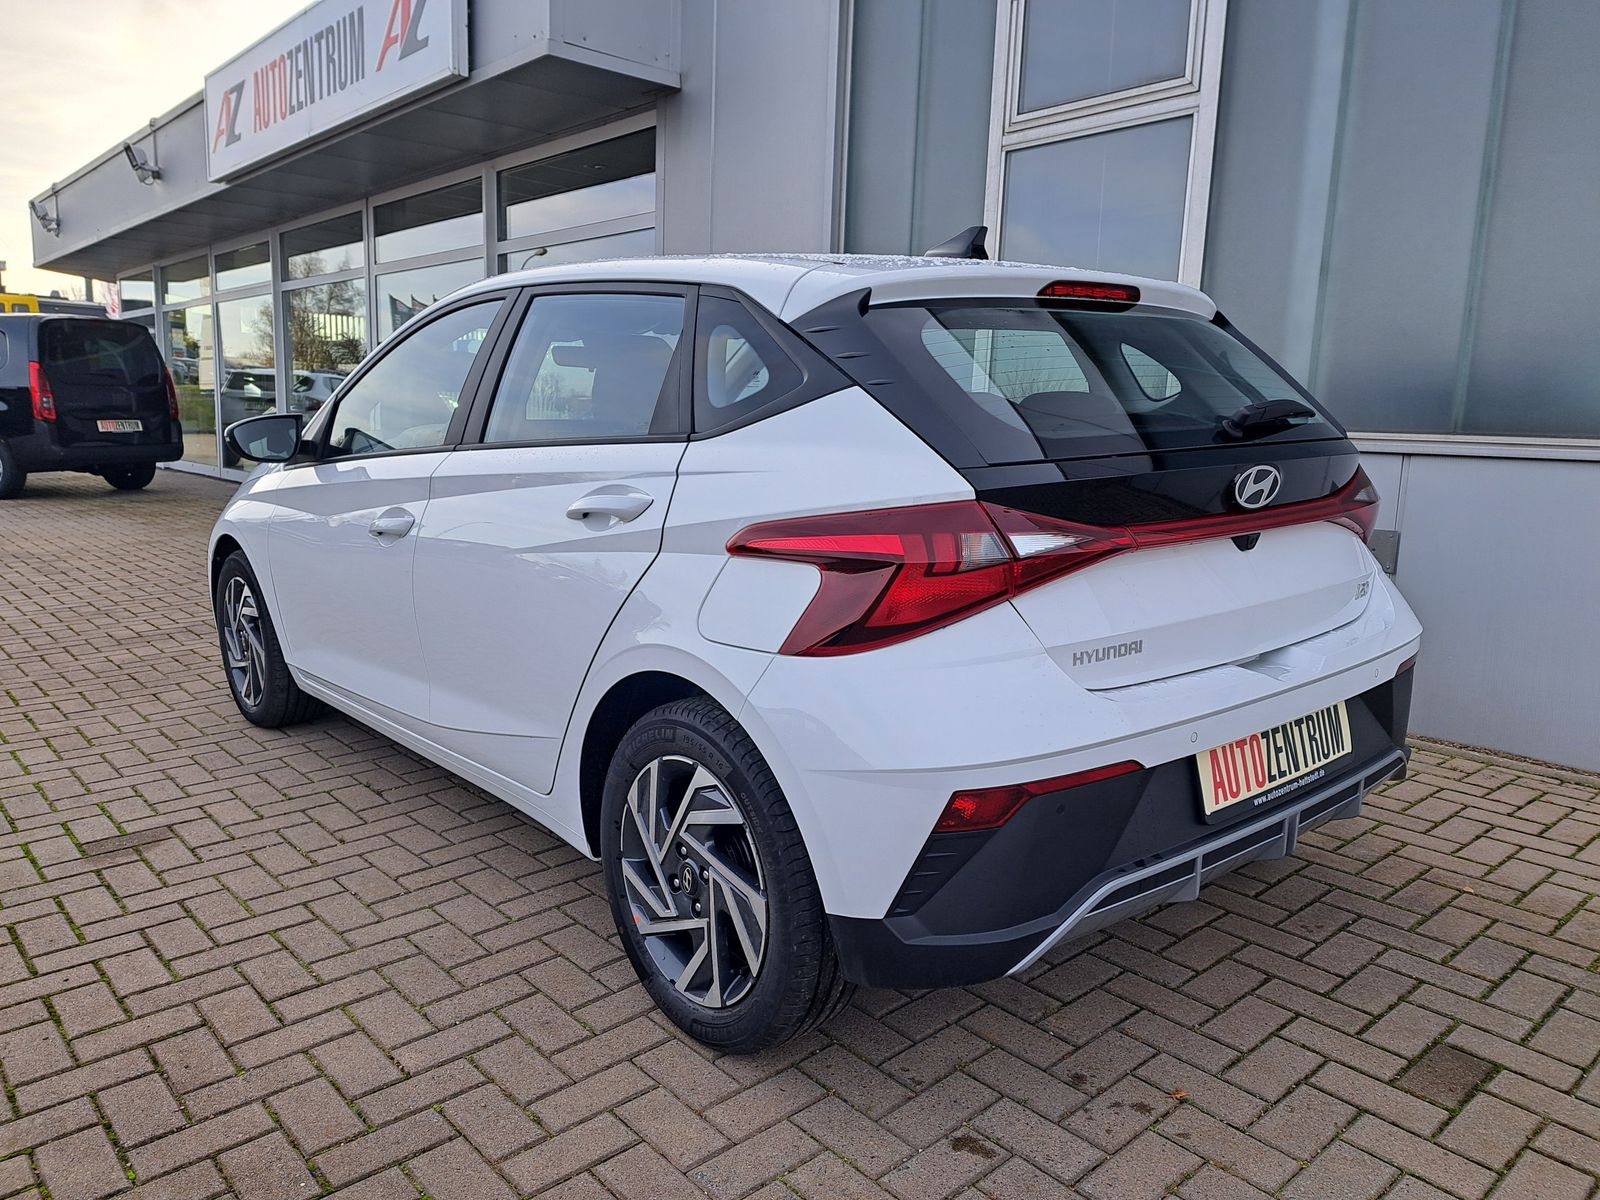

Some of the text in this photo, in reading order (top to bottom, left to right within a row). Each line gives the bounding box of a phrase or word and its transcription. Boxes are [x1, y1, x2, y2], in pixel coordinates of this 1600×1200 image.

[212, 79, 246, 154] AZ
[253, 6, 366, 134] AUTOZENTRUM
[1072, 639, 1144, 667] HYUNDAI
[1209, 704, 1345, 806] AUTOZENTRUM
